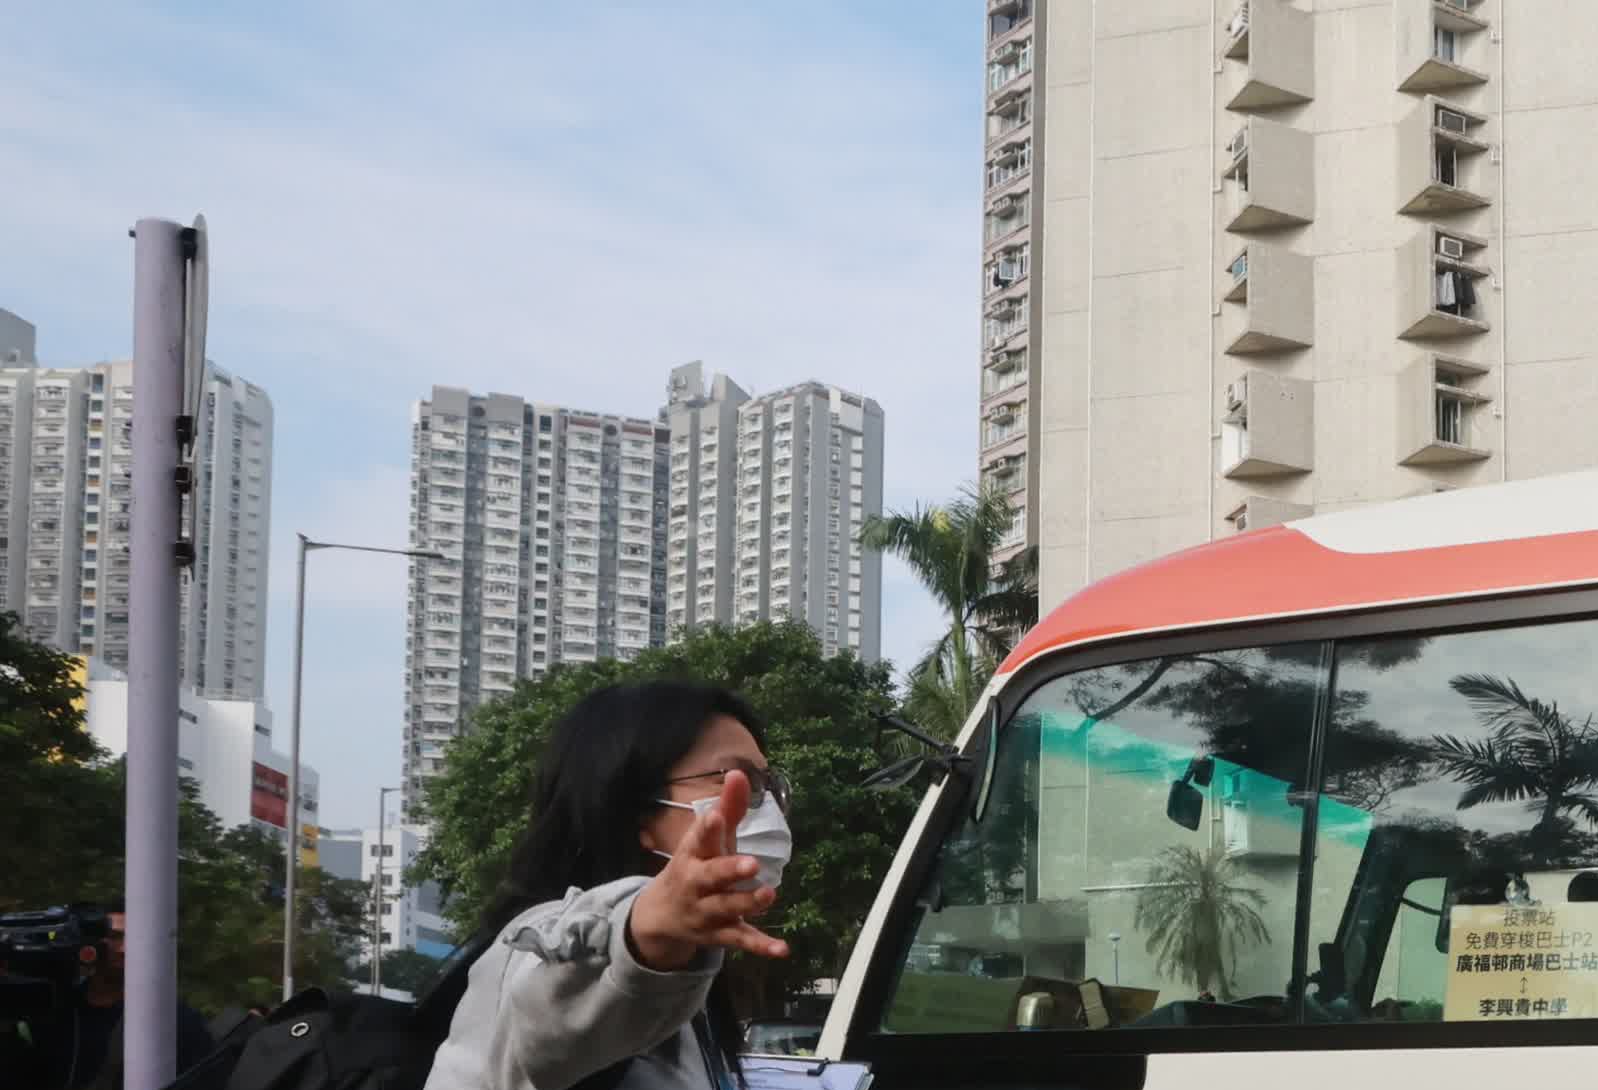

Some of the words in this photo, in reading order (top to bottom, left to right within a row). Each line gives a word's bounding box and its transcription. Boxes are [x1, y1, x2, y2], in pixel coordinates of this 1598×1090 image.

[1503, 909, 1556, 928] 投票站
[1465, 932, 1593, 950] 免費穿梭巴士P2
[1479, 998, 1569, 1017] 李興貴中學
